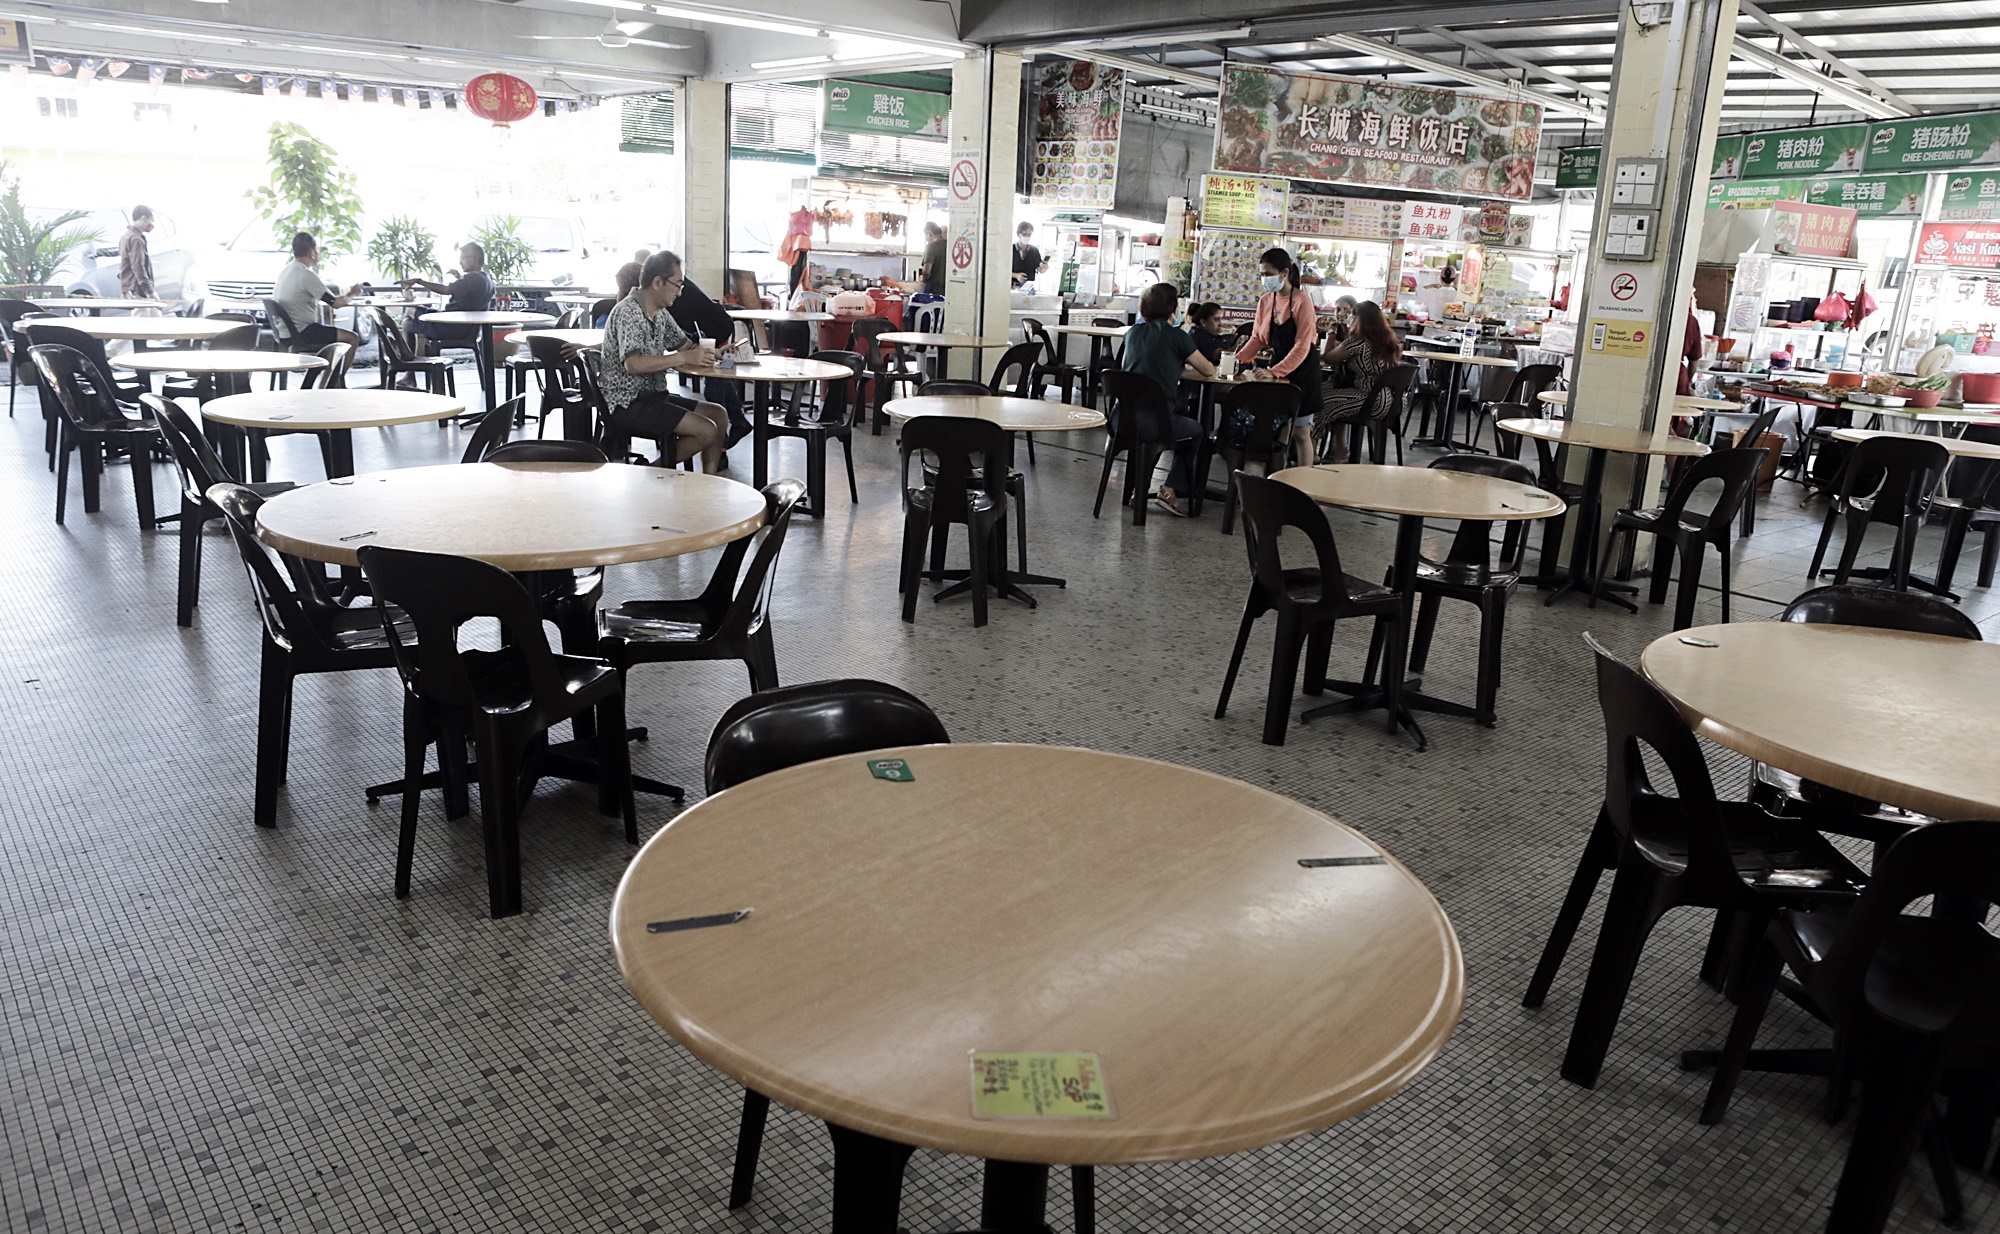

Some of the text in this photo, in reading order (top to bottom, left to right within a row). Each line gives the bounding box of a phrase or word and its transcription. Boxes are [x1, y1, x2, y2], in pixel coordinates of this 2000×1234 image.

[867, 115, 910, 128] CHICKEN RICE
[1298, 104, 1470, 155] 长城海鲜饭店
[1911, 123, 1971, 149] 猪肠粉
[1875, 132, 1893, 141] MILO
[1310, 142, 1451, 165] CHANG CHEN SEAFOOD RESTAURANT
[1749, 143, 1763, 151] MILO
[1777, 136, 1824, 159] 猪肉粉
[1902, 149, 1973, 162] CHEE CHEONG FUN
[1776, 158, 1820, 170] PORK NOODLE
[1952, 181, 1969, 189] MILO
[1977, 177, 2000, 198] 鱼
[1207, 189, 1228, 197] STEAMED
[1412, 205, 1451, 220] 鱼丸粉
[1869, 202, 1883, 210] MEE
[1408, 222, 1448, 236] 鱼滑粉
[1799, 232, 1850, 251] PORK NOODLE
[1952, 242, 1976, 255] Nasi
